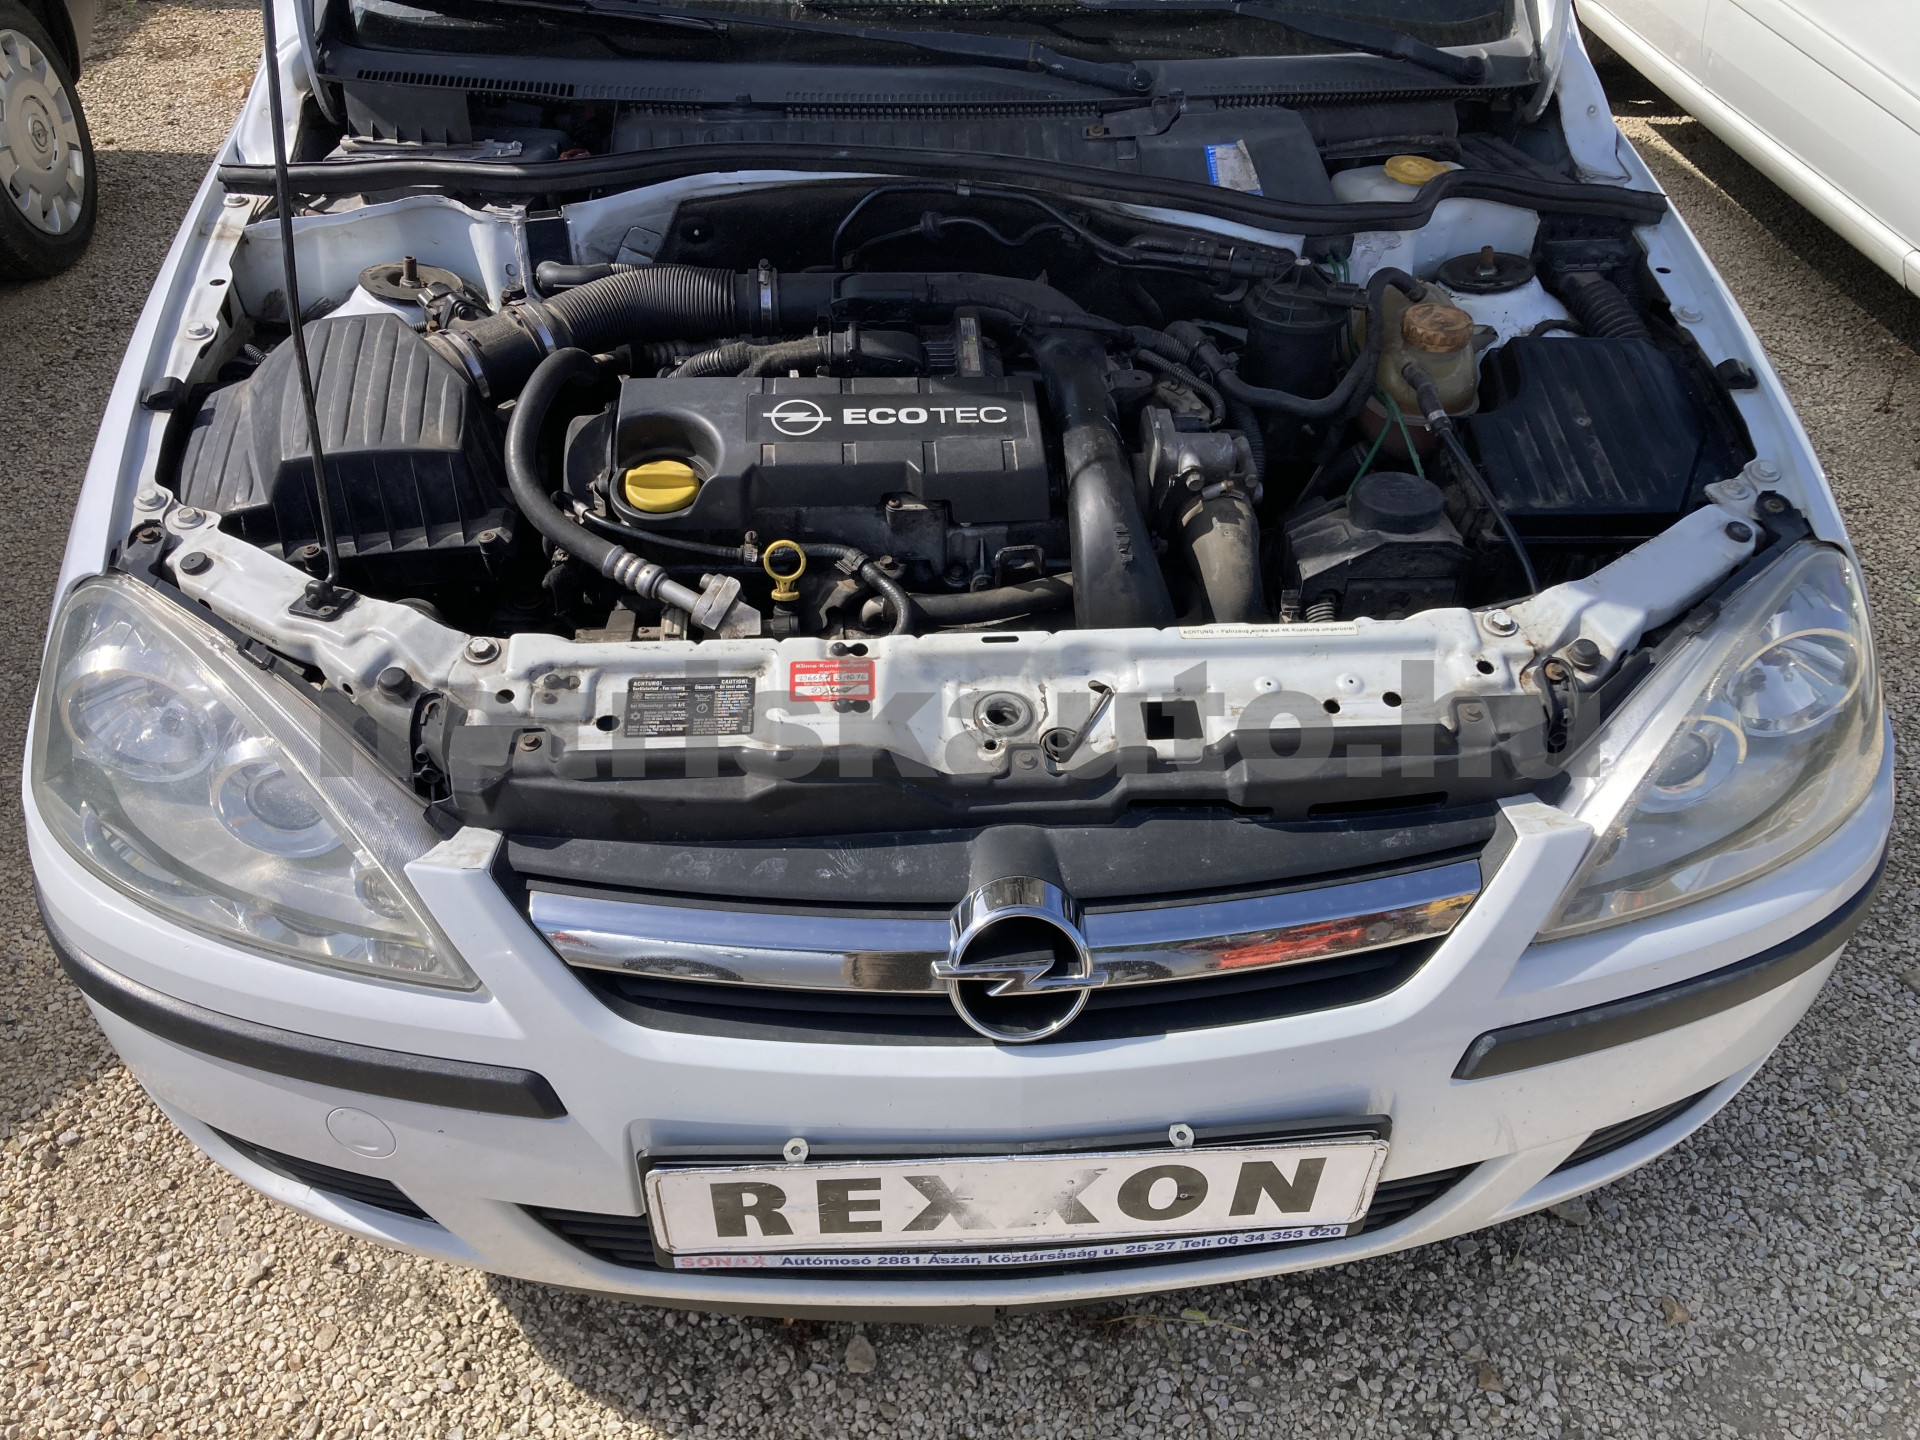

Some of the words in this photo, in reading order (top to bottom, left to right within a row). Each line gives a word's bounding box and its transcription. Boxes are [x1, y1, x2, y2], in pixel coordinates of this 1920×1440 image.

[842, 406, 1008, 425] ECOTEC
[707, 1156, 1328, 1239] REXXON
[679, 1255, 768, 1267] SONAX
[781, 1256, 871, 1266] Autómosó
[877, 1256, 920, 1265] 2881
[928, 1251, 981, 1266] Ászár,
[987, 1249, 1098, 1264] Köztársaság
[1125, 1241, 1177, 1254] 25-27
[1181, 1239, 1212, 1248] Tel:
[1217, 1235, 1239, 1245] 06
[1244, 1233, 1266, 1243] 34
[1271, 1229, 1303, 1241] 353
[1309, 1226, 1341, 1237] 620
